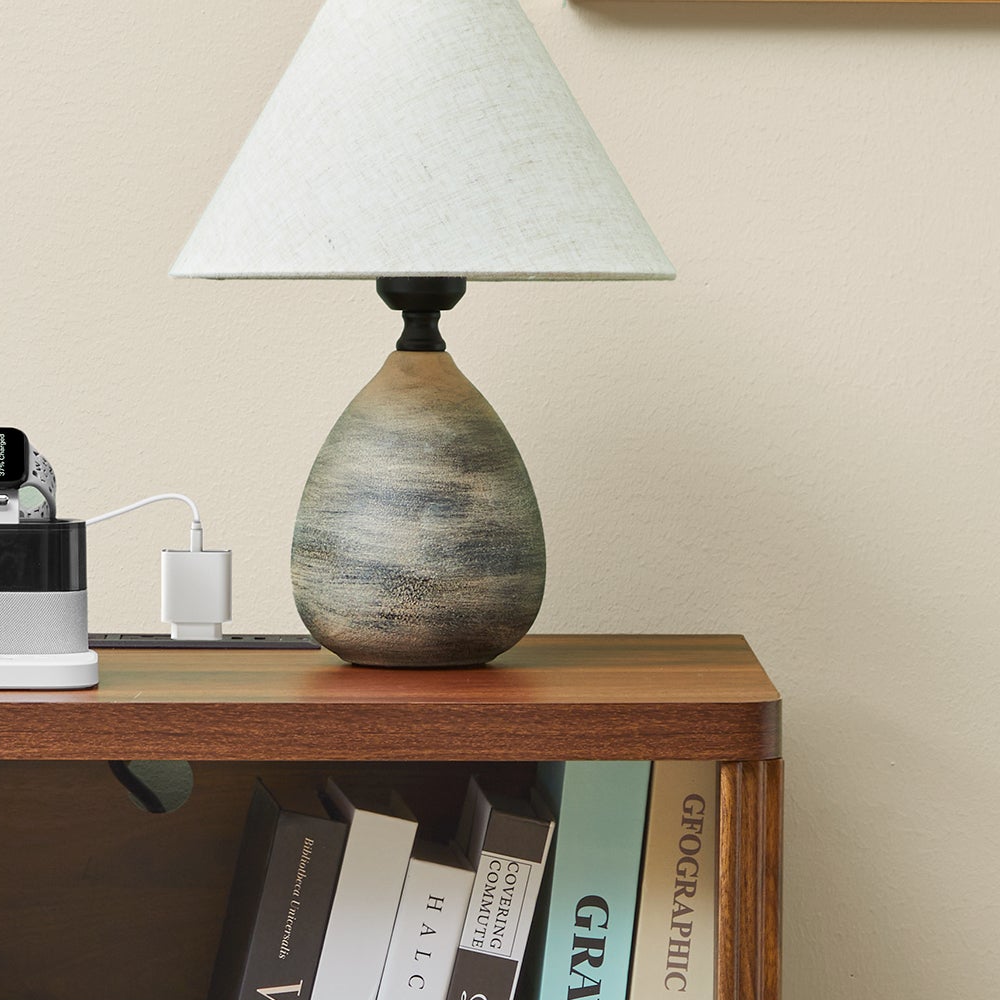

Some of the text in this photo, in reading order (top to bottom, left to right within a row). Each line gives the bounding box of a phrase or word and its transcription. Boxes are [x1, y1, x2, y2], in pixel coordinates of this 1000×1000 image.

[292, 836, 315, 897] Bibliotheca
[471, 859, 502, 949] COMMUTE
[489, 861, 520, 950] COVERING
